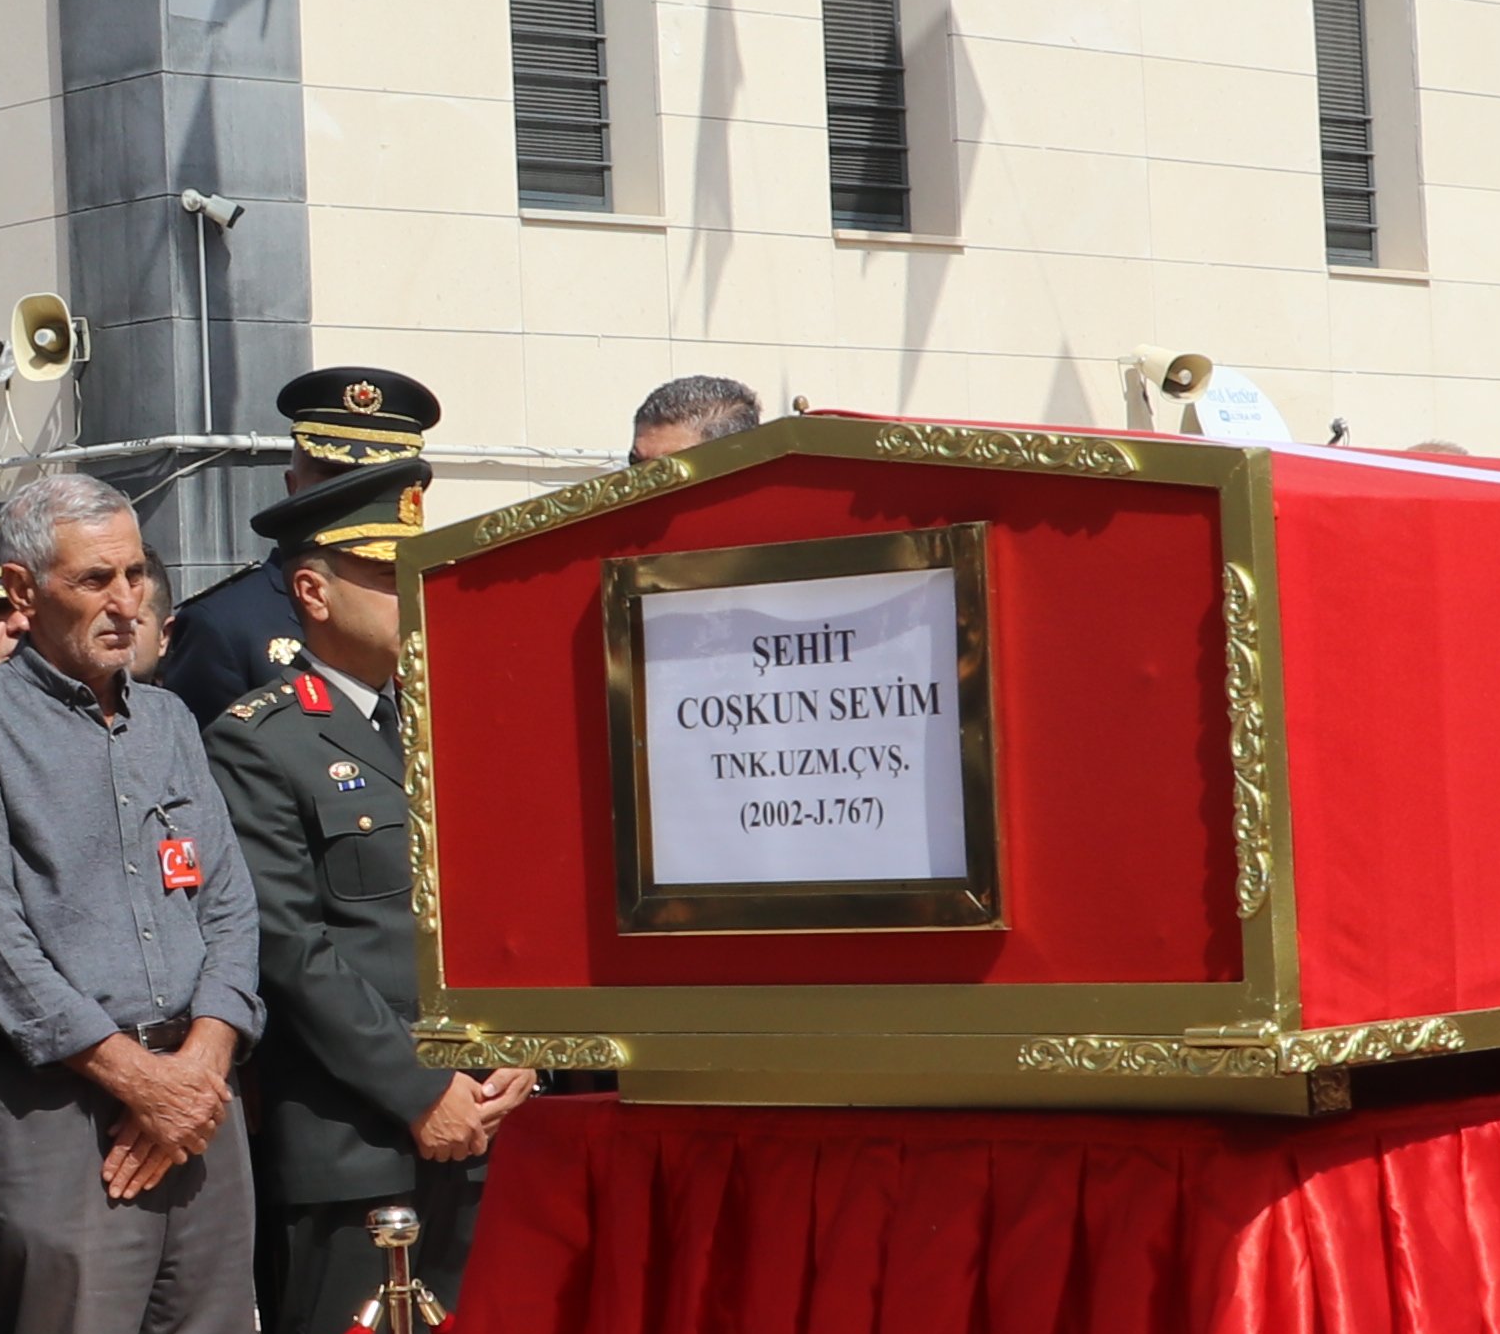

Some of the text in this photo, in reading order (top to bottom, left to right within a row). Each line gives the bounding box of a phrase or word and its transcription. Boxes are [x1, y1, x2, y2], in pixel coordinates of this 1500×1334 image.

[752, 623, 856, 676] ŞEHİT
[677, 676, 942, 734] COŞKUN SEVİM
[711, 744, 910, 779] TNK.UZM.ÇVŞ.
[740, 797, 884, 834] (2002-J.767)
